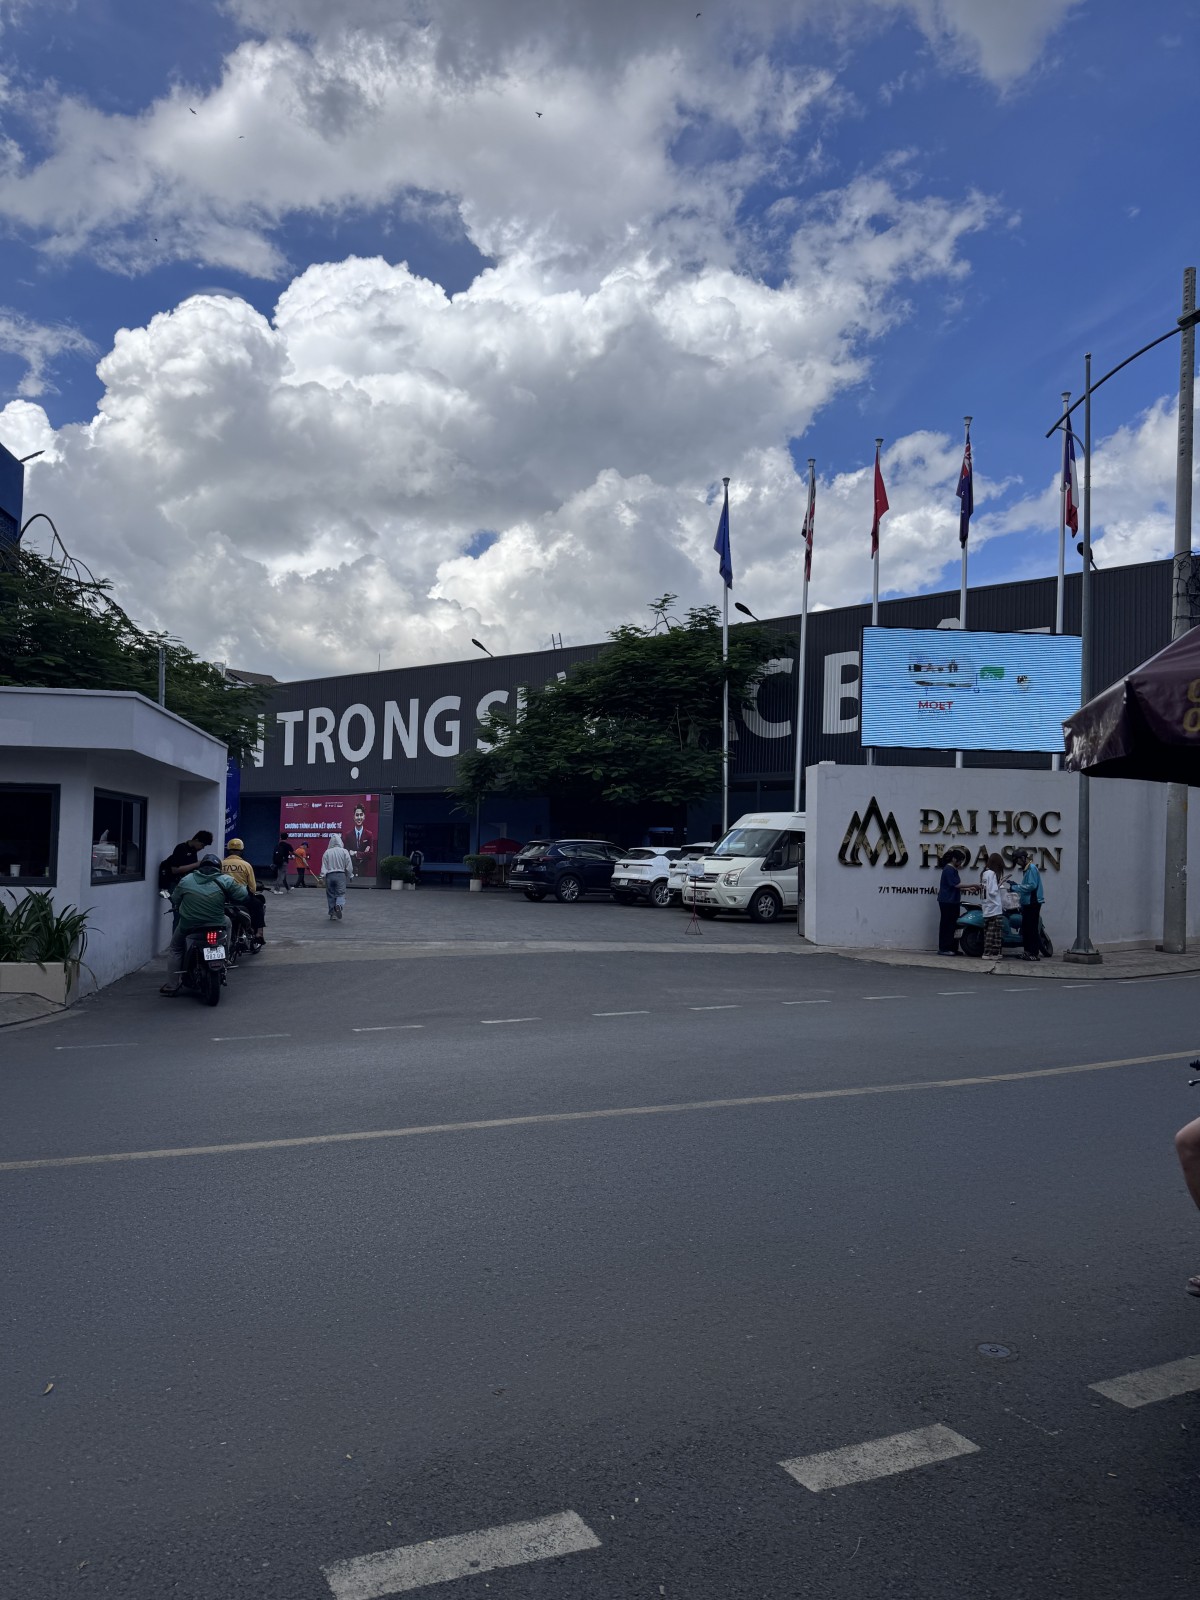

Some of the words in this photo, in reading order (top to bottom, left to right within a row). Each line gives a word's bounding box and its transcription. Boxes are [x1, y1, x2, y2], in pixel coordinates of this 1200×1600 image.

[276, 695, 462, 779] TRỌNG
[919, 808, 979, 838] ĐẠI
[988, 810, 1062, 839] HỌC
[878, 886, 890, 894] 7/1
